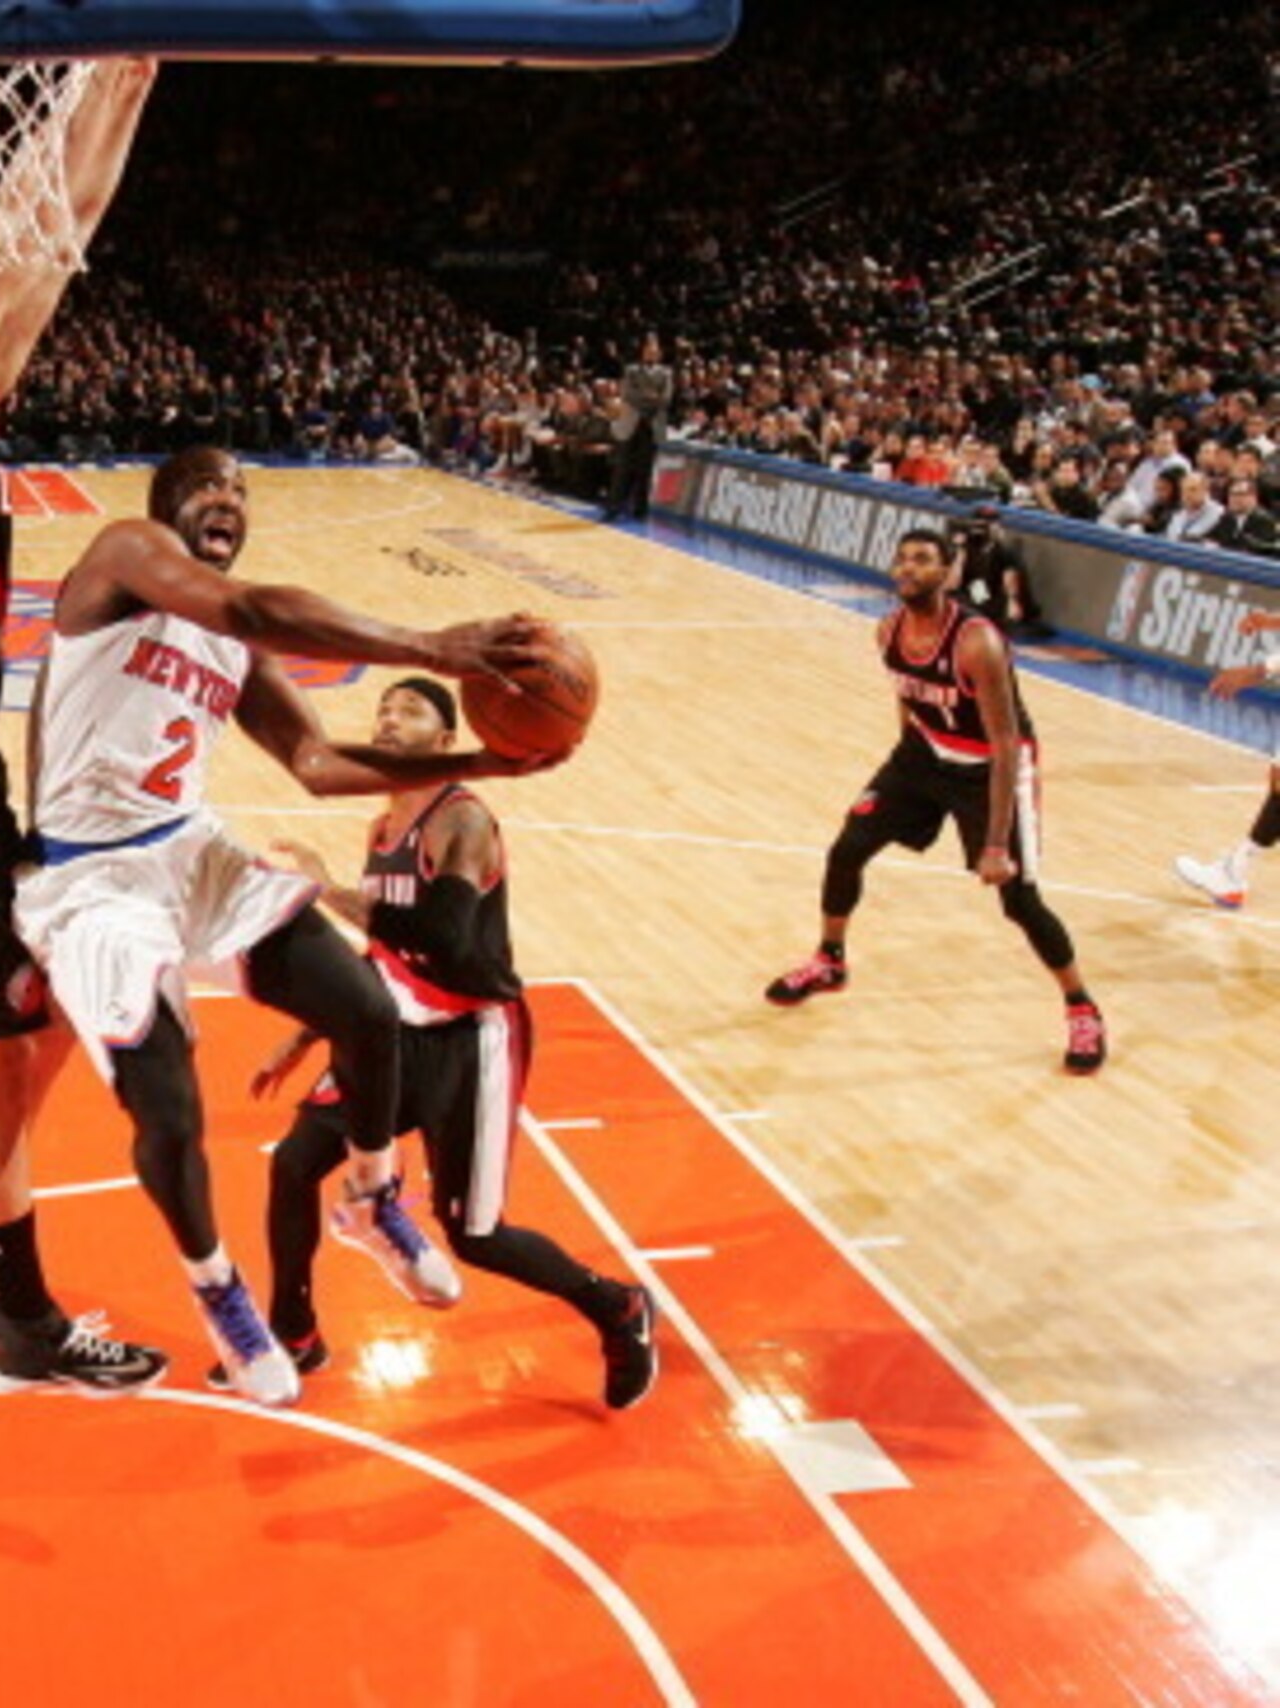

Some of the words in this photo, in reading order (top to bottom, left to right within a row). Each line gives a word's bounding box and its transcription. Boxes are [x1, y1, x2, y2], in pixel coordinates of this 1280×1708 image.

[812, 489, 876, 563] NBA
[123, 636, 199, 694] NEW
[138, 715, 196, 804] 2
